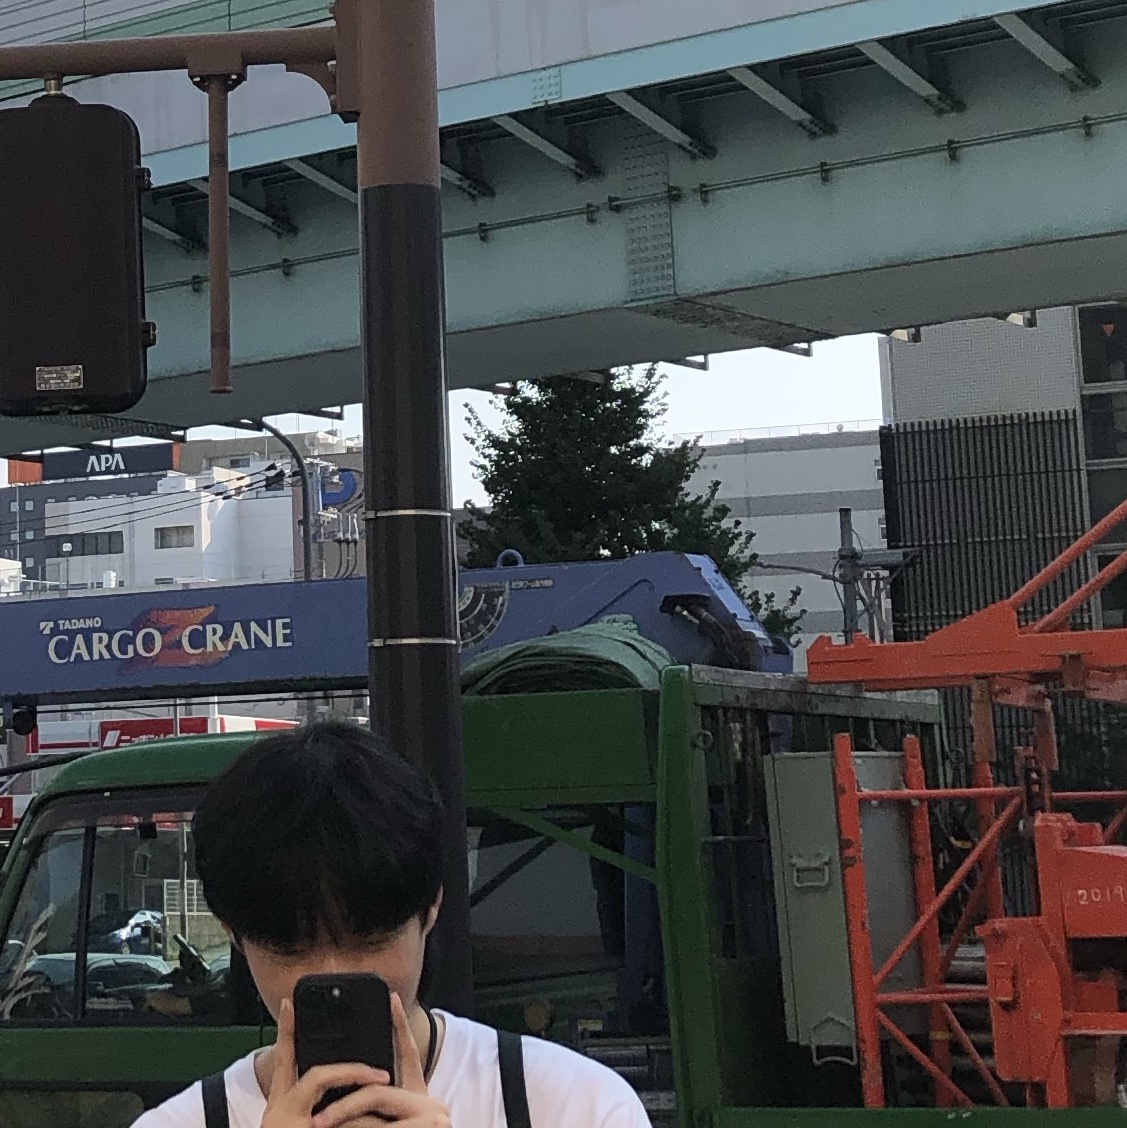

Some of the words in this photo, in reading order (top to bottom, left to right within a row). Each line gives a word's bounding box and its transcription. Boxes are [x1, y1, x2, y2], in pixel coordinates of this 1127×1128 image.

[86, 453, 125, 472] APA
[58, 617, 102, 631] TADANO
[47, 627, 163, 664] CARGO
[181, 618, 293, 654] CRANE
